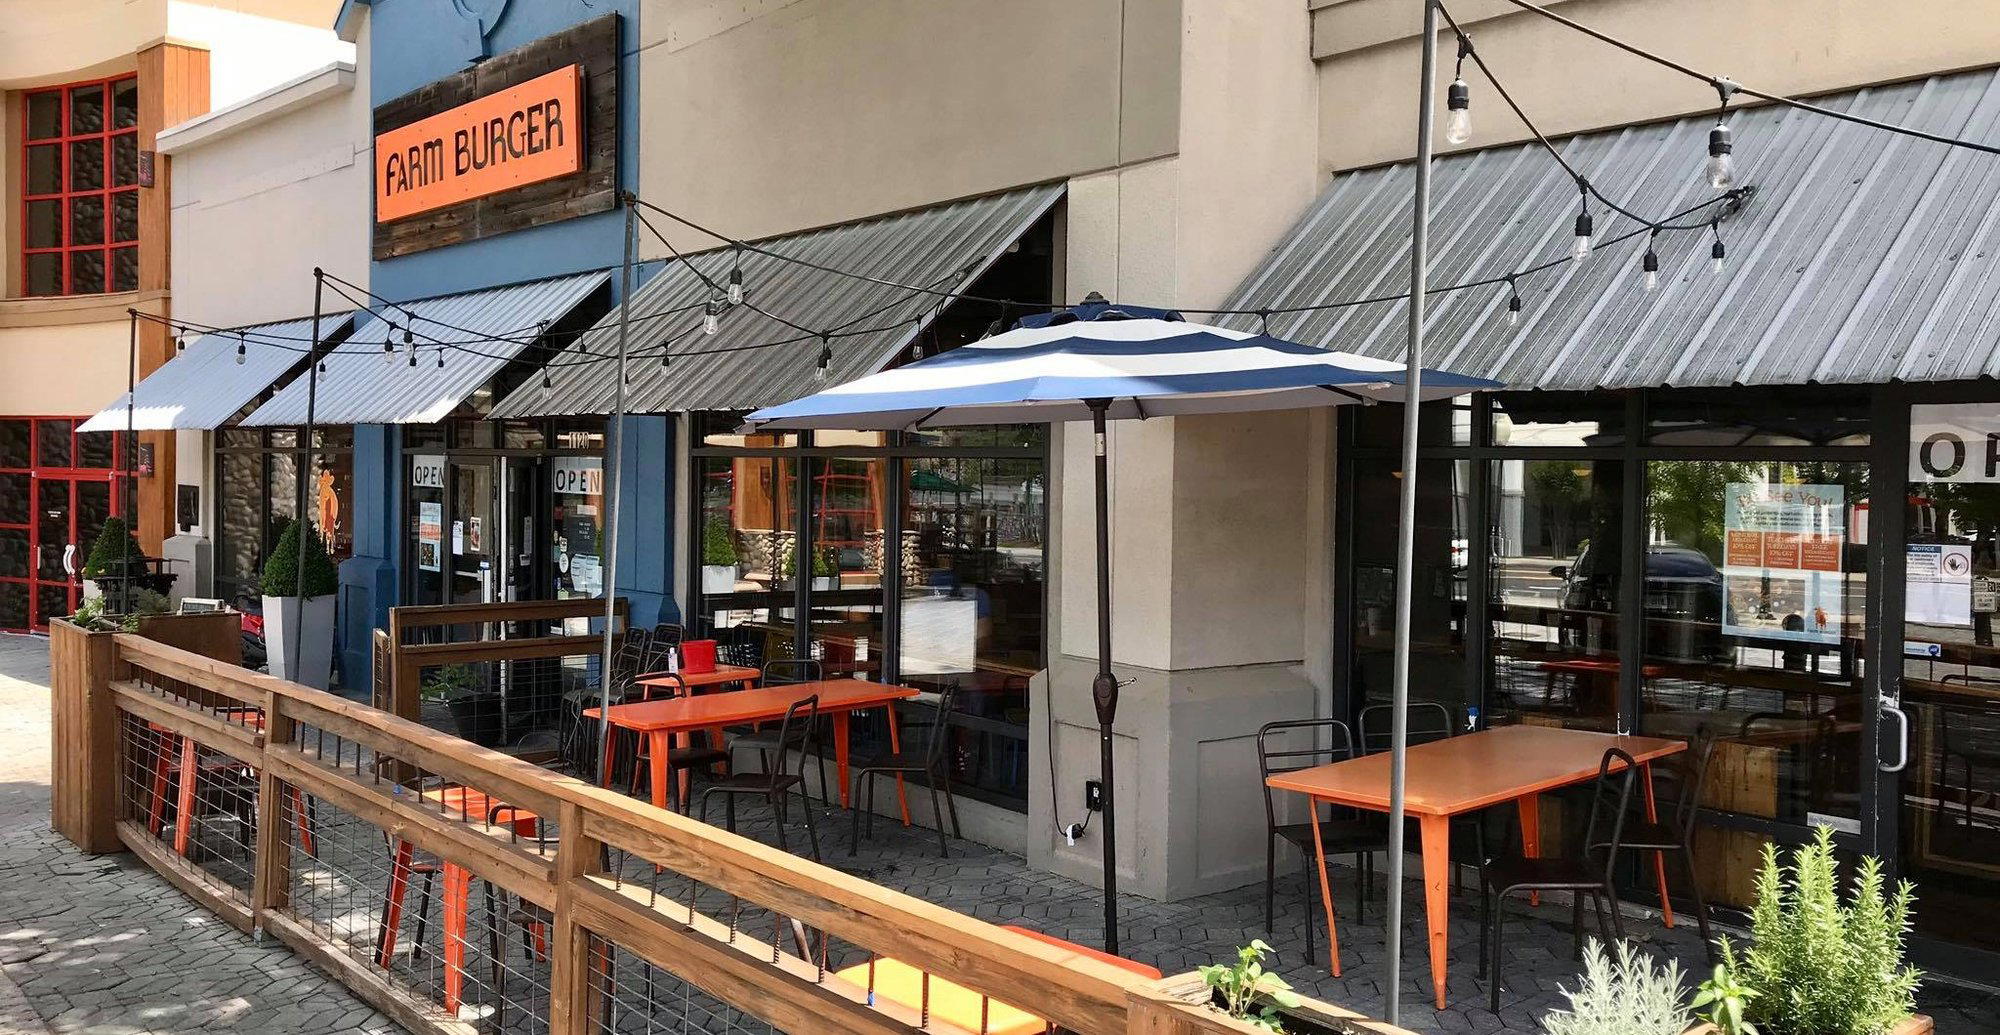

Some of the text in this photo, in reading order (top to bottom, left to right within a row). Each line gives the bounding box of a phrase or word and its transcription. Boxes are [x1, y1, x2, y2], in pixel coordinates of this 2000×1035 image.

[386, 98, 564, 196] FARM BURGER
[568, 431, 590, 450] 1120
[555, 469, 601, 493] OPEN
